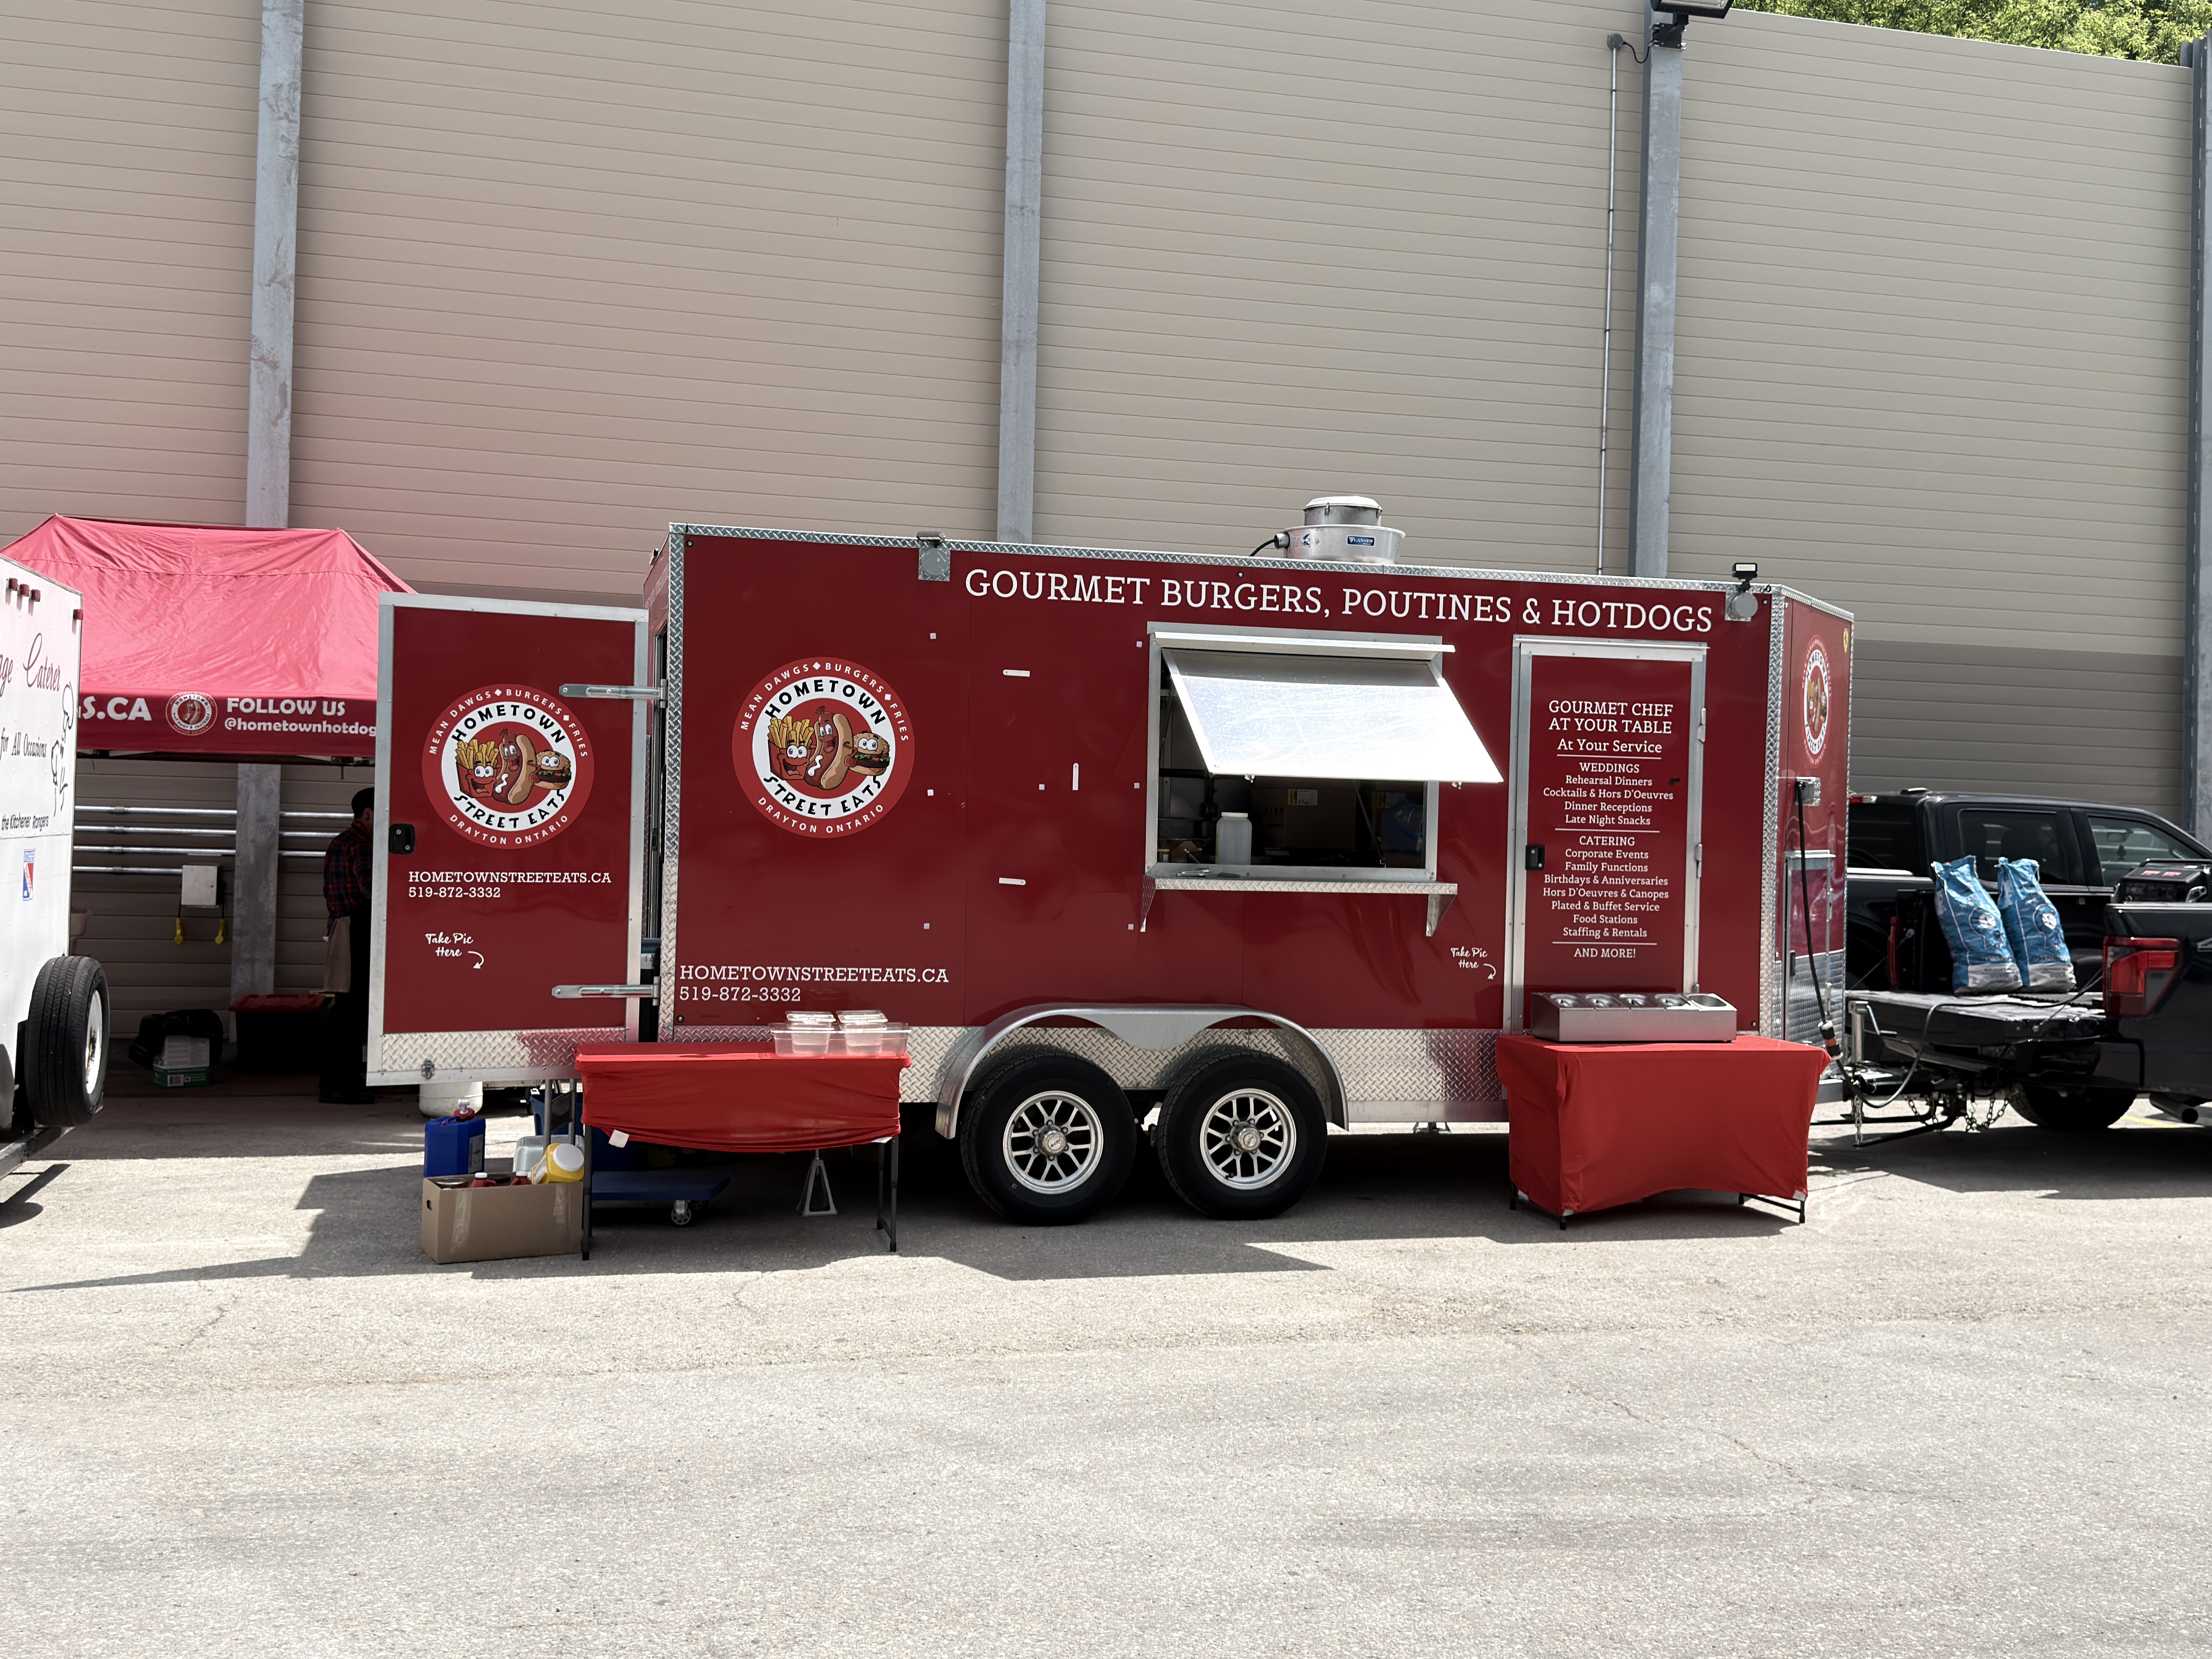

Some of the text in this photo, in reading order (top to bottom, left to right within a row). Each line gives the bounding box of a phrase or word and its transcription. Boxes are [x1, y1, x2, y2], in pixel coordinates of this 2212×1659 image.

[965, 569, 1712, 632] GOURMET BURGERS, POUTINES & HOTDOGS
[23, 633, 60, 692] Caterer
[78, 696, 152, 721] S.CA
[227, 698, 316, 714] FOLLOW
[323, 701, 345, 716] US
[741, 663, 908, 741] MEAN DAWGS BURGERS FRIES
[764, 679, 886, 725] HOMETOWN
[1549, 700, 1673, 717] GOURMET CHEF
[429, 689, 587, 757] MEAN DAWGS BURGERS FRIES
[452, 705, 565, 743] HOMETOWN
[1548, 718, 1672, 734] AT YOUR TABLE
[0, 727, 47, 761] for All Occasions
[1557, 738, 1662, 753] At Your Service
[1579, 762, 1639, 773] WEDDINGS
[1566, 775, 1652, 786] Rehearsal Dinners
[763, 776, 881, 816] STREET EATS
[1543, 787, 1673, 800] Cocktails & Hors D'Oeuvres
[454, 789, 565, 828] STREET EATS
[1564, 801, 1652, 814] Dinner Receptions
[10, 812, 31, 830] Kitchener
[33, 815, 49, 831] Rangers
[759, 797, 883, 833] DRAYTON ONTARIO
[1565, 814, 1650, 827] Late Night Snacks
[450, 814, 568, 844] DRAYTON ONTARIO
[1579, 836, 1635, 846] CATERING
[1565, 848, 1649, 860] Corporate Events
[1565, 862, 1648, 874] Family Functions
[409, 871, 611, 883] HOMETOWNSTREETEATS.CA
[1544, 874, 1668, 886] Birthdays & Anniversaries
[409, 886, 500, 898] 519-872-3332
[1543, 887, 1669, 901] Hors D'Oeuvres & Canopes
[1552, 900, 1660, 911] Plated & Buffet Service
[1573, 914, 1638, 924] Food Stations
[425, 931, 474, 945] Take Pic
[1563, 927, 1647, 939] Staffing & Rentals
[435, 946, 462, 957] Here
[1450, 946, 1488, 958] Take Pic
[1574, 948, 1636, 958] AND MORE!
[1458, 959, 1479, 969] Here
[680, 965, 949, 982] HOMETOWNSTREETEATS.CA
[679, 986, 800, 1001] 519-872-3332
